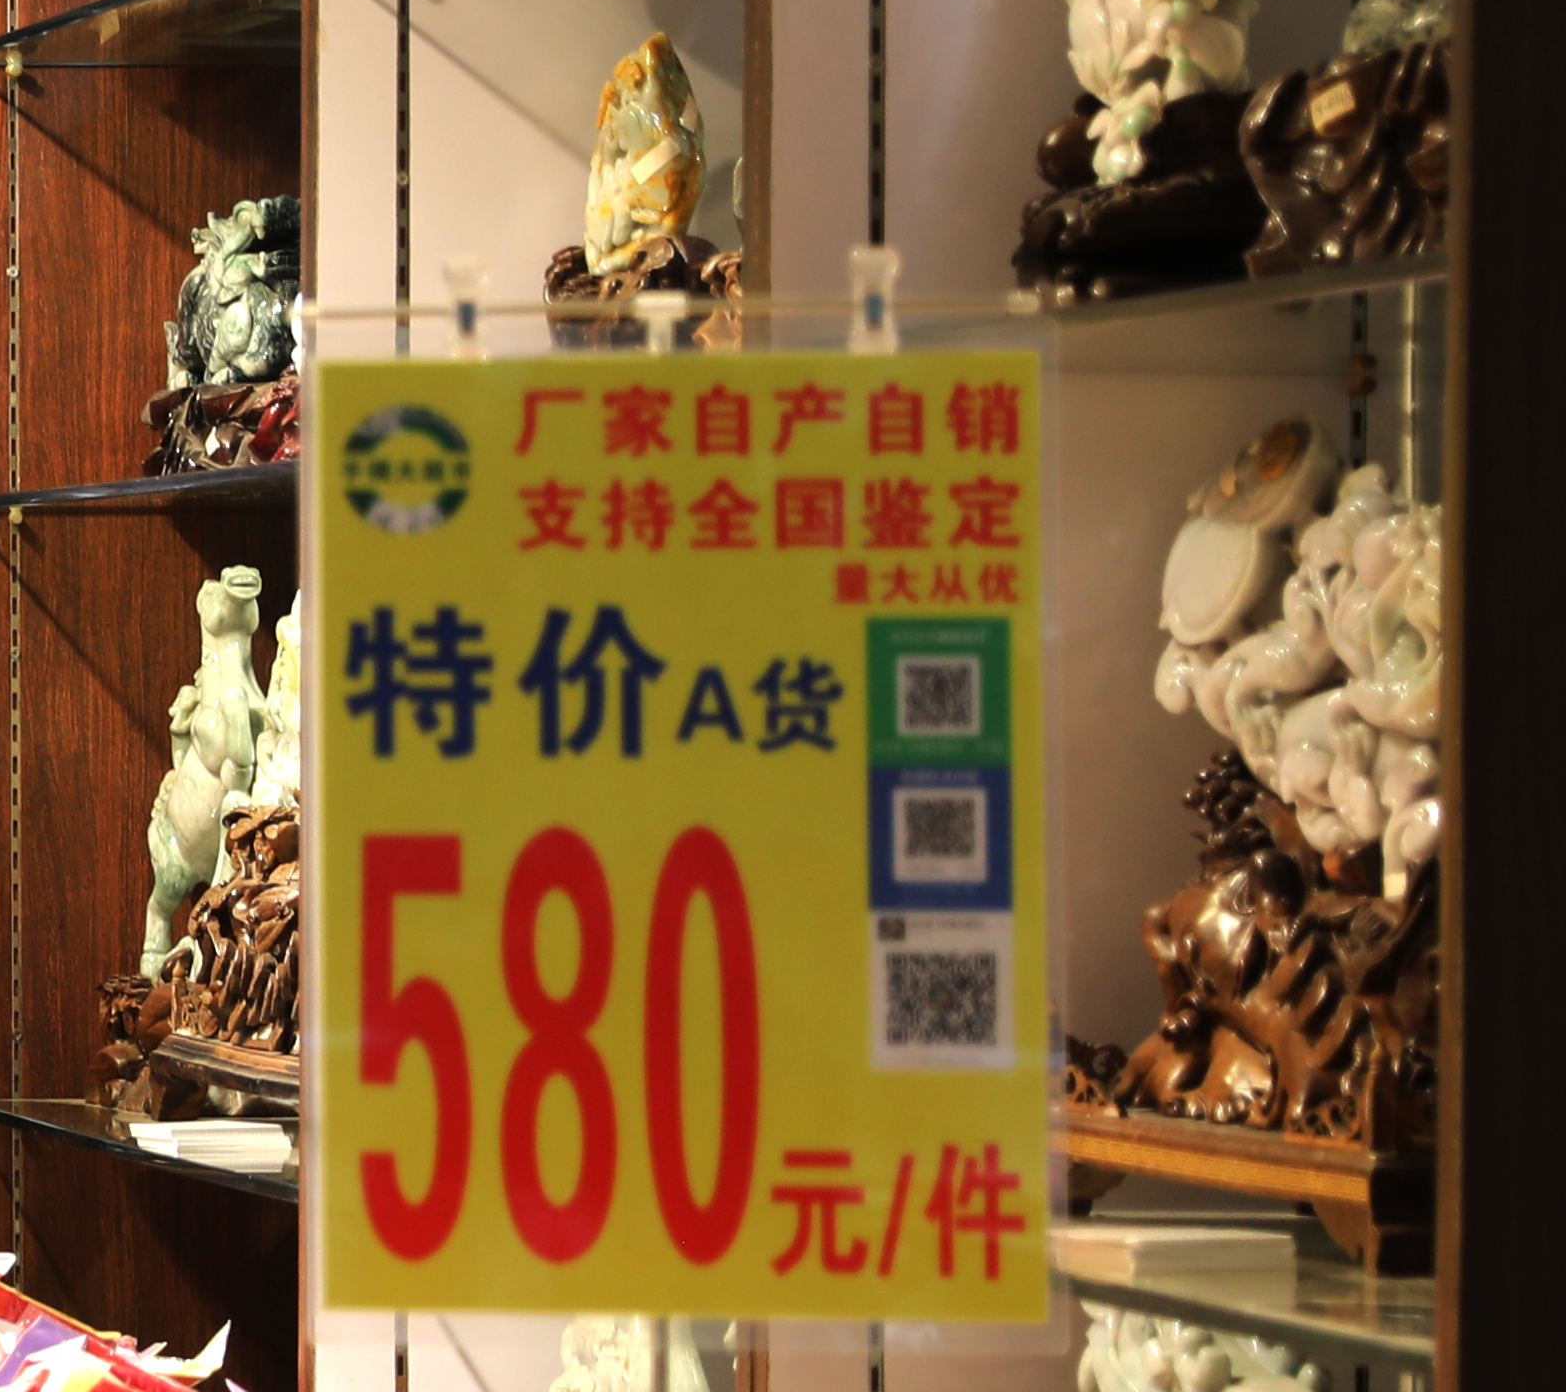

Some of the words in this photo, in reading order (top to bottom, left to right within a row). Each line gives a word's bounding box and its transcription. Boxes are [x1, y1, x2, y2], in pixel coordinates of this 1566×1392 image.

[514, 382, 1022, 459] 厂家自产自销
[519, 474, 1022, 552] 支持全国鉴定
[833, 562, 1021, 605] 量大从优
[344, 604, 846, 759] 特价A货
[359, 825, 1027, 1282] 580元/件
